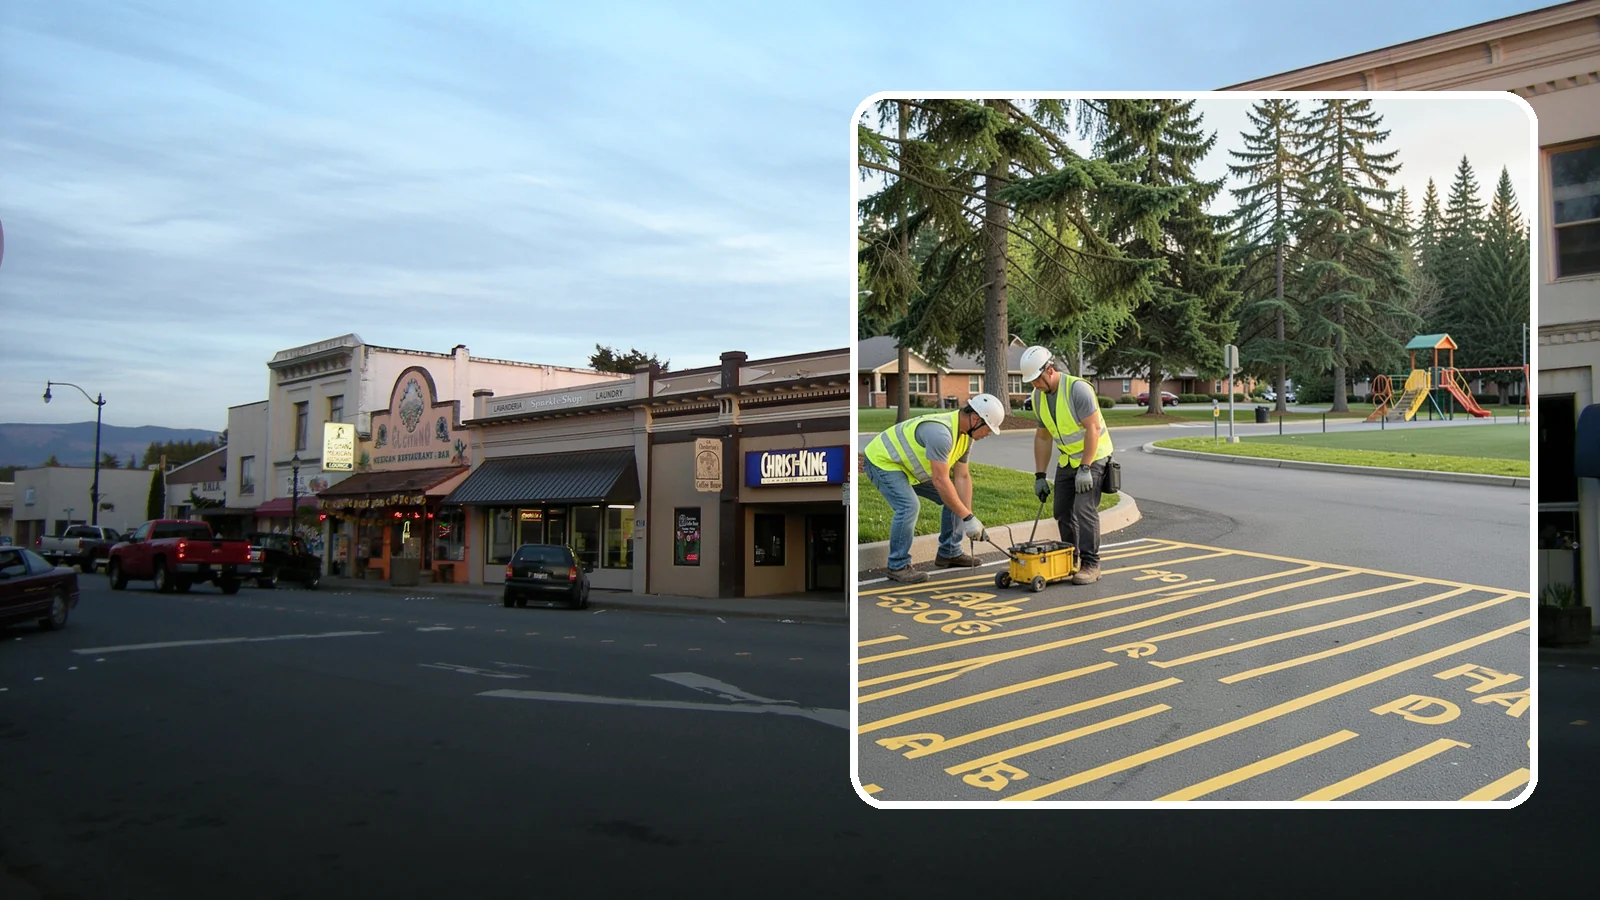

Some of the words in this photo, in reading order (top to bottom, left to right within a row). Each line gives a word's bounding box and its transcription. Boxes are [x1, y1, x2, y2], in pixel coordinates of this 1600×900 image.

[595, 388, 623, 400] LAUNDRY
[493, 402, 522, 412] LAVANDERIA
[397, 451, 434, 463] RESTAURANT
[437, 450, 450, 459] BAR
[799, 450, 827, 476] KING
